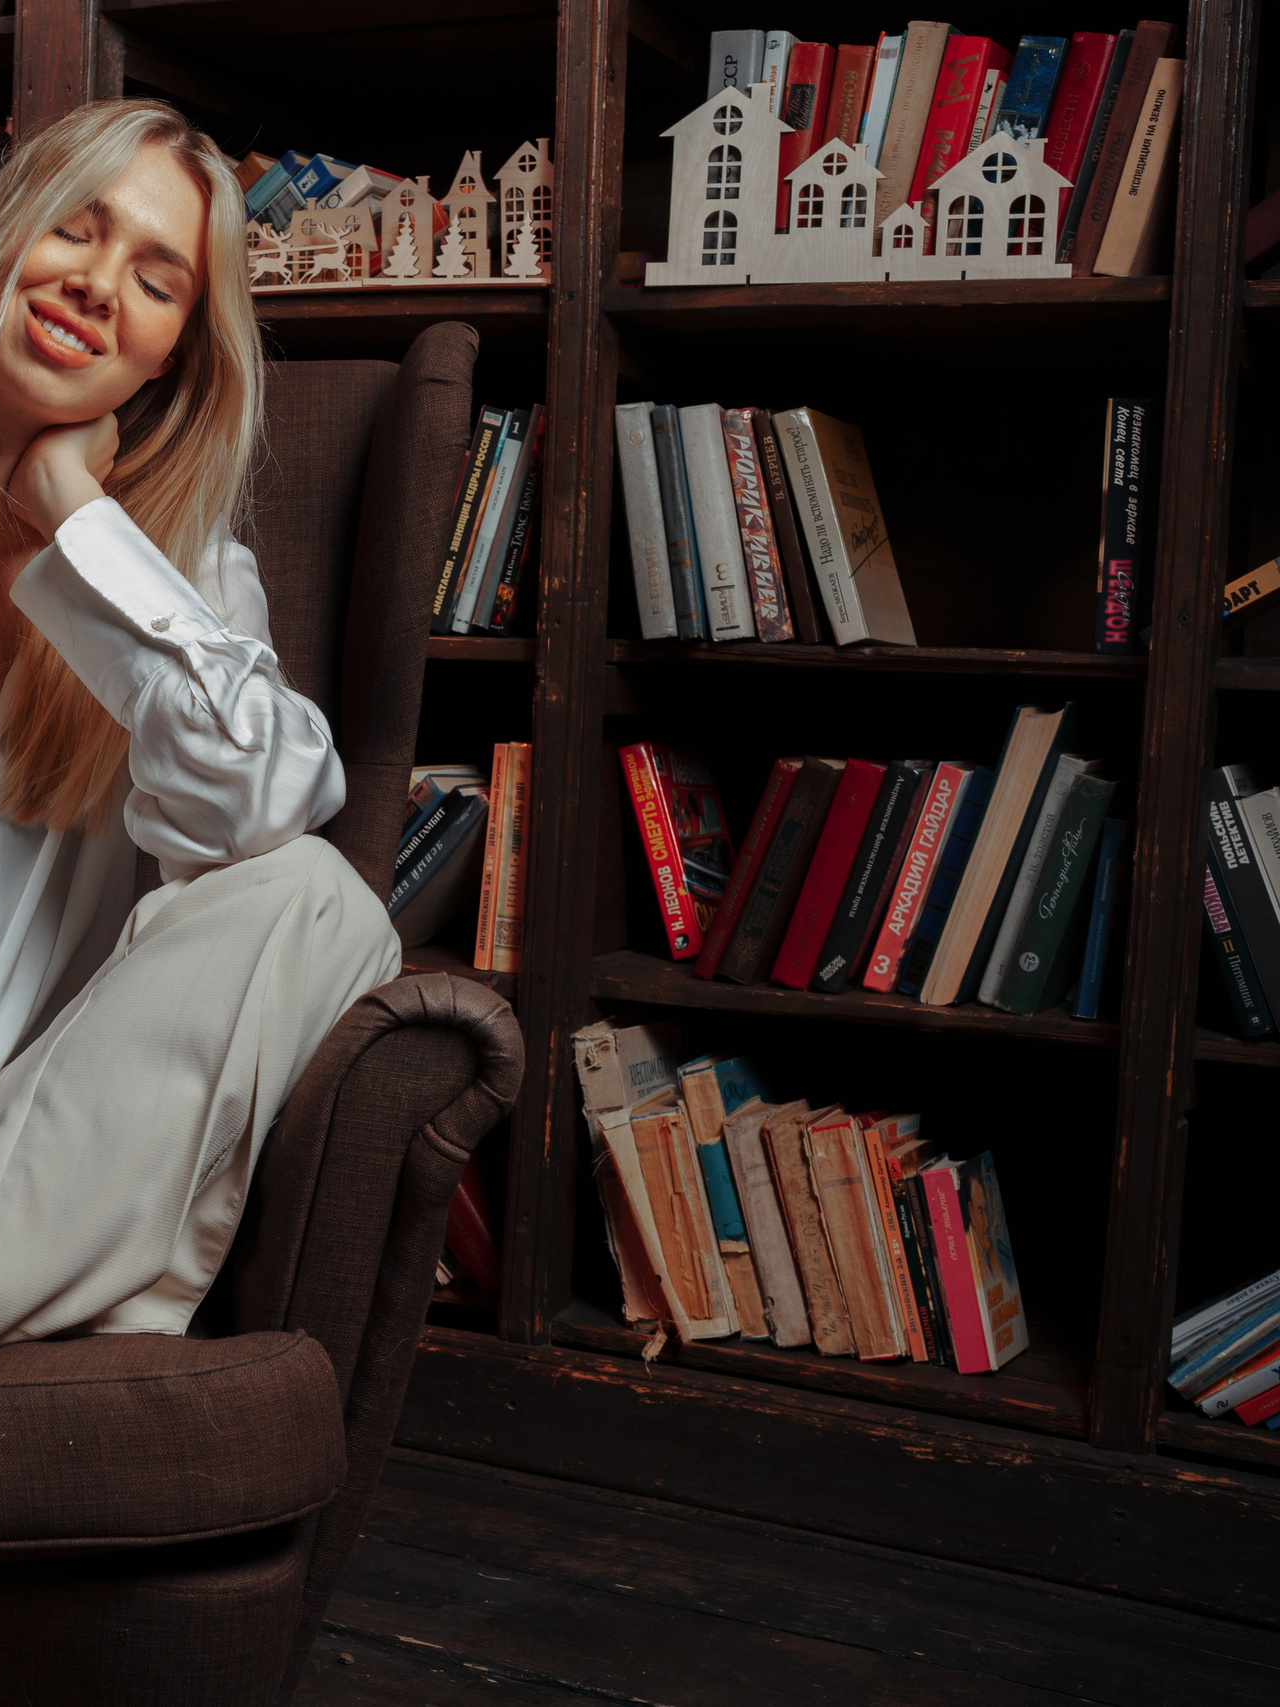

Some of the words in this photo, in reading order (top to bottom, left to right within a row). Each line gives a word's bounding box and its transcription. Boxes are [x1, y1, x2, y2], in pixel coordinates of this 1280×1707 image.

[1151, 89, 1166, 122] ЗЕМЛЮ
[1147, 124, 1156, 136] НА
[1129, 138, 1152, 196] ЭКСПЕДИЦИЯ
[512, 422, 521, 434] 1
[1114, 406, 1129, 444] Конец
[1129, 405, 1145, 480] Незнакомец
[763, 436, 782, 485] БУРЦЕВ
[786, 427, 808, 464] старое?
[729, 433, 765, 528] РЮРИК
[1114, 448, 1126, 486] света
[800, 464, 824, 522] вспоминать
[1129, 484, 1138, 492] в
[432, 560, 455, 615] АНАСТАСИЯ
[450, 502, 471, 553] ЗВЕНЯЩИЕ
[465, 469, 481, 508] КЕДРЫ
[475, 429, 493, 468] РОССИИ
[817, 523, 827, 536] ли
[1126, 496, 1138, 545] зеркале
[820, 537, 834, 565] Надо
[715, 562, 728, 581] 3
[828, 573, 841, 605] МОЖАЕВ
[834, 605, 845, 624] Борис
[626, 753, 643, 796] ПРЯМОМ
[639, 767, 655, 800] ЭФИРЕ
[637, 795, 644, 803] В
[879, 775, 905, 832] Американская
[419, 806, 446, 840] ГАМБИТ
[641, 800, 669, 861] СМЕРТЬ
[1035, 813, 1056, 862] ТОЛСТОЙ
[1219, 800, 1250, 865] ДЕТЕКТИВ
[411, 840, 444, 881] ЯСНЫЙ
[854, 832, 885, 896] фантастическая
[888, 850, 930, 937] АРКАДИЙ
[919, 778, 955, 849] ГАЙДАР
[658, 865, 682, 917] ЛЕОНОВ
[848, 895, 862, 918] проза
[1039, 857, 1073, 919] Геннадий
[671, 919, 685, 931] Н.
[873, 954, 891, 975] 3
[873, 1143, 885, 1177] Драгункин
[880, 1177, 891, 1209] Александр
[949, 1236, 958, 1261] СЕРИЯ
[1226, 1292, 1248, 1306] войне
